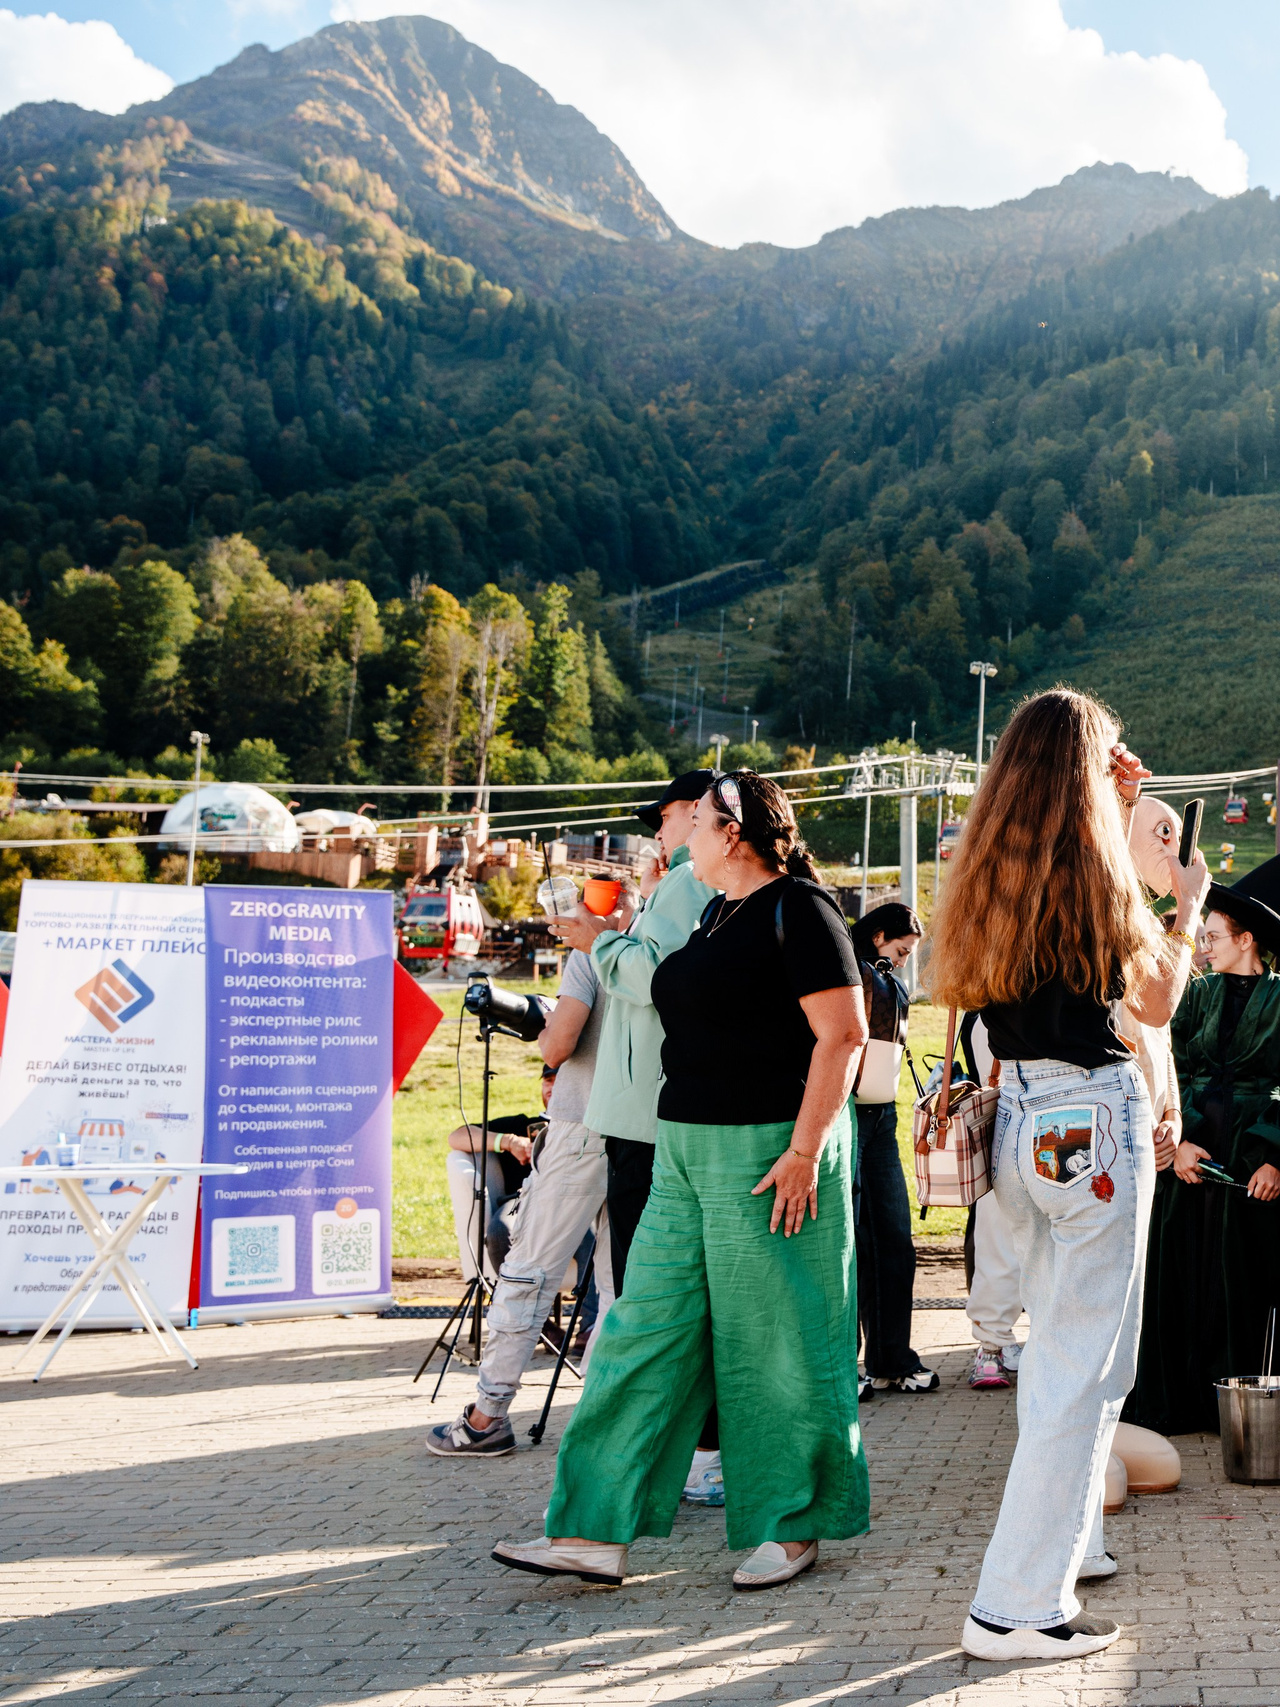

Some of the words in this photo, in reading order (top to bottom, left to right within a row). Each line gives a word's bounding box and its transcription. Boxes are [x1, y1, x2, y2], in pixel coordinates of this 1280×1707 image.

[229, 901, 366, 920] ZEROGRAVITY
[269, 925, 333, 942] MEDIA
[57, 937, 137, 952] МАРКЕТ
[224, 948, 357, 968] Производство
[224, 975, 367, 990] видеоконтента:
[230, 996, 305, 1008] подкасты
[230, 1015, 322, 1029] экспертные
[325, 1016, 362, 1029] рилс
[65, 1036, 112, 1044] МАСТЕРА
[115, 1037, 155, 1045] ЖИЗНИ
[230, 1035, 318, 1049] рекламные
[321, 1035, 378, 1049] ролики
[26, 1060, 69, 1071] ДЕЛАЙ
[73, 1061, 122, 1071] БИЗНЕС
[126, 1063, 187, 1074] ОТДЫХАЯ!
[230, 1055, 317, 1069] репортажи
[28, 1074, 78, 1085] Получай
[81, 1077, 124, 1086] деньги
[78, 1089, 130, 1099] живёшь!
[218, 1084, 238, 1097] От
[240, 1085, 313, 1097] написания
[315, 1084, 378, 1096] сценария
[218, 1104, 237, 1116] до
[239, 1103, 293, 1114] съемки,
[295, 1101, 353, 1113] монтажа
[218, 1122, 228, 1131] и
[231, 1118, 328, 1133] продвижения.
[234, 1145, 308, 1156] Собственная
[310, 1143, 353, 1154] подкаст
[286, 1159, 325, 1170] центре
[327, 1157, 355, 1168] Сочи
[215, 1190, 278, 1201] Подпишись
[279, 1186, 312, 1197] чтобы
[314, 1187, 327, 1195] не
[328, 1185, 375, 1195] потерять
[0, 1210, 66, 1220] ПРЕВРАТИ
[8, 1224, 62, 1235] ДОХОДЫ
[24, 1252, 72, 1263] Хочешь
